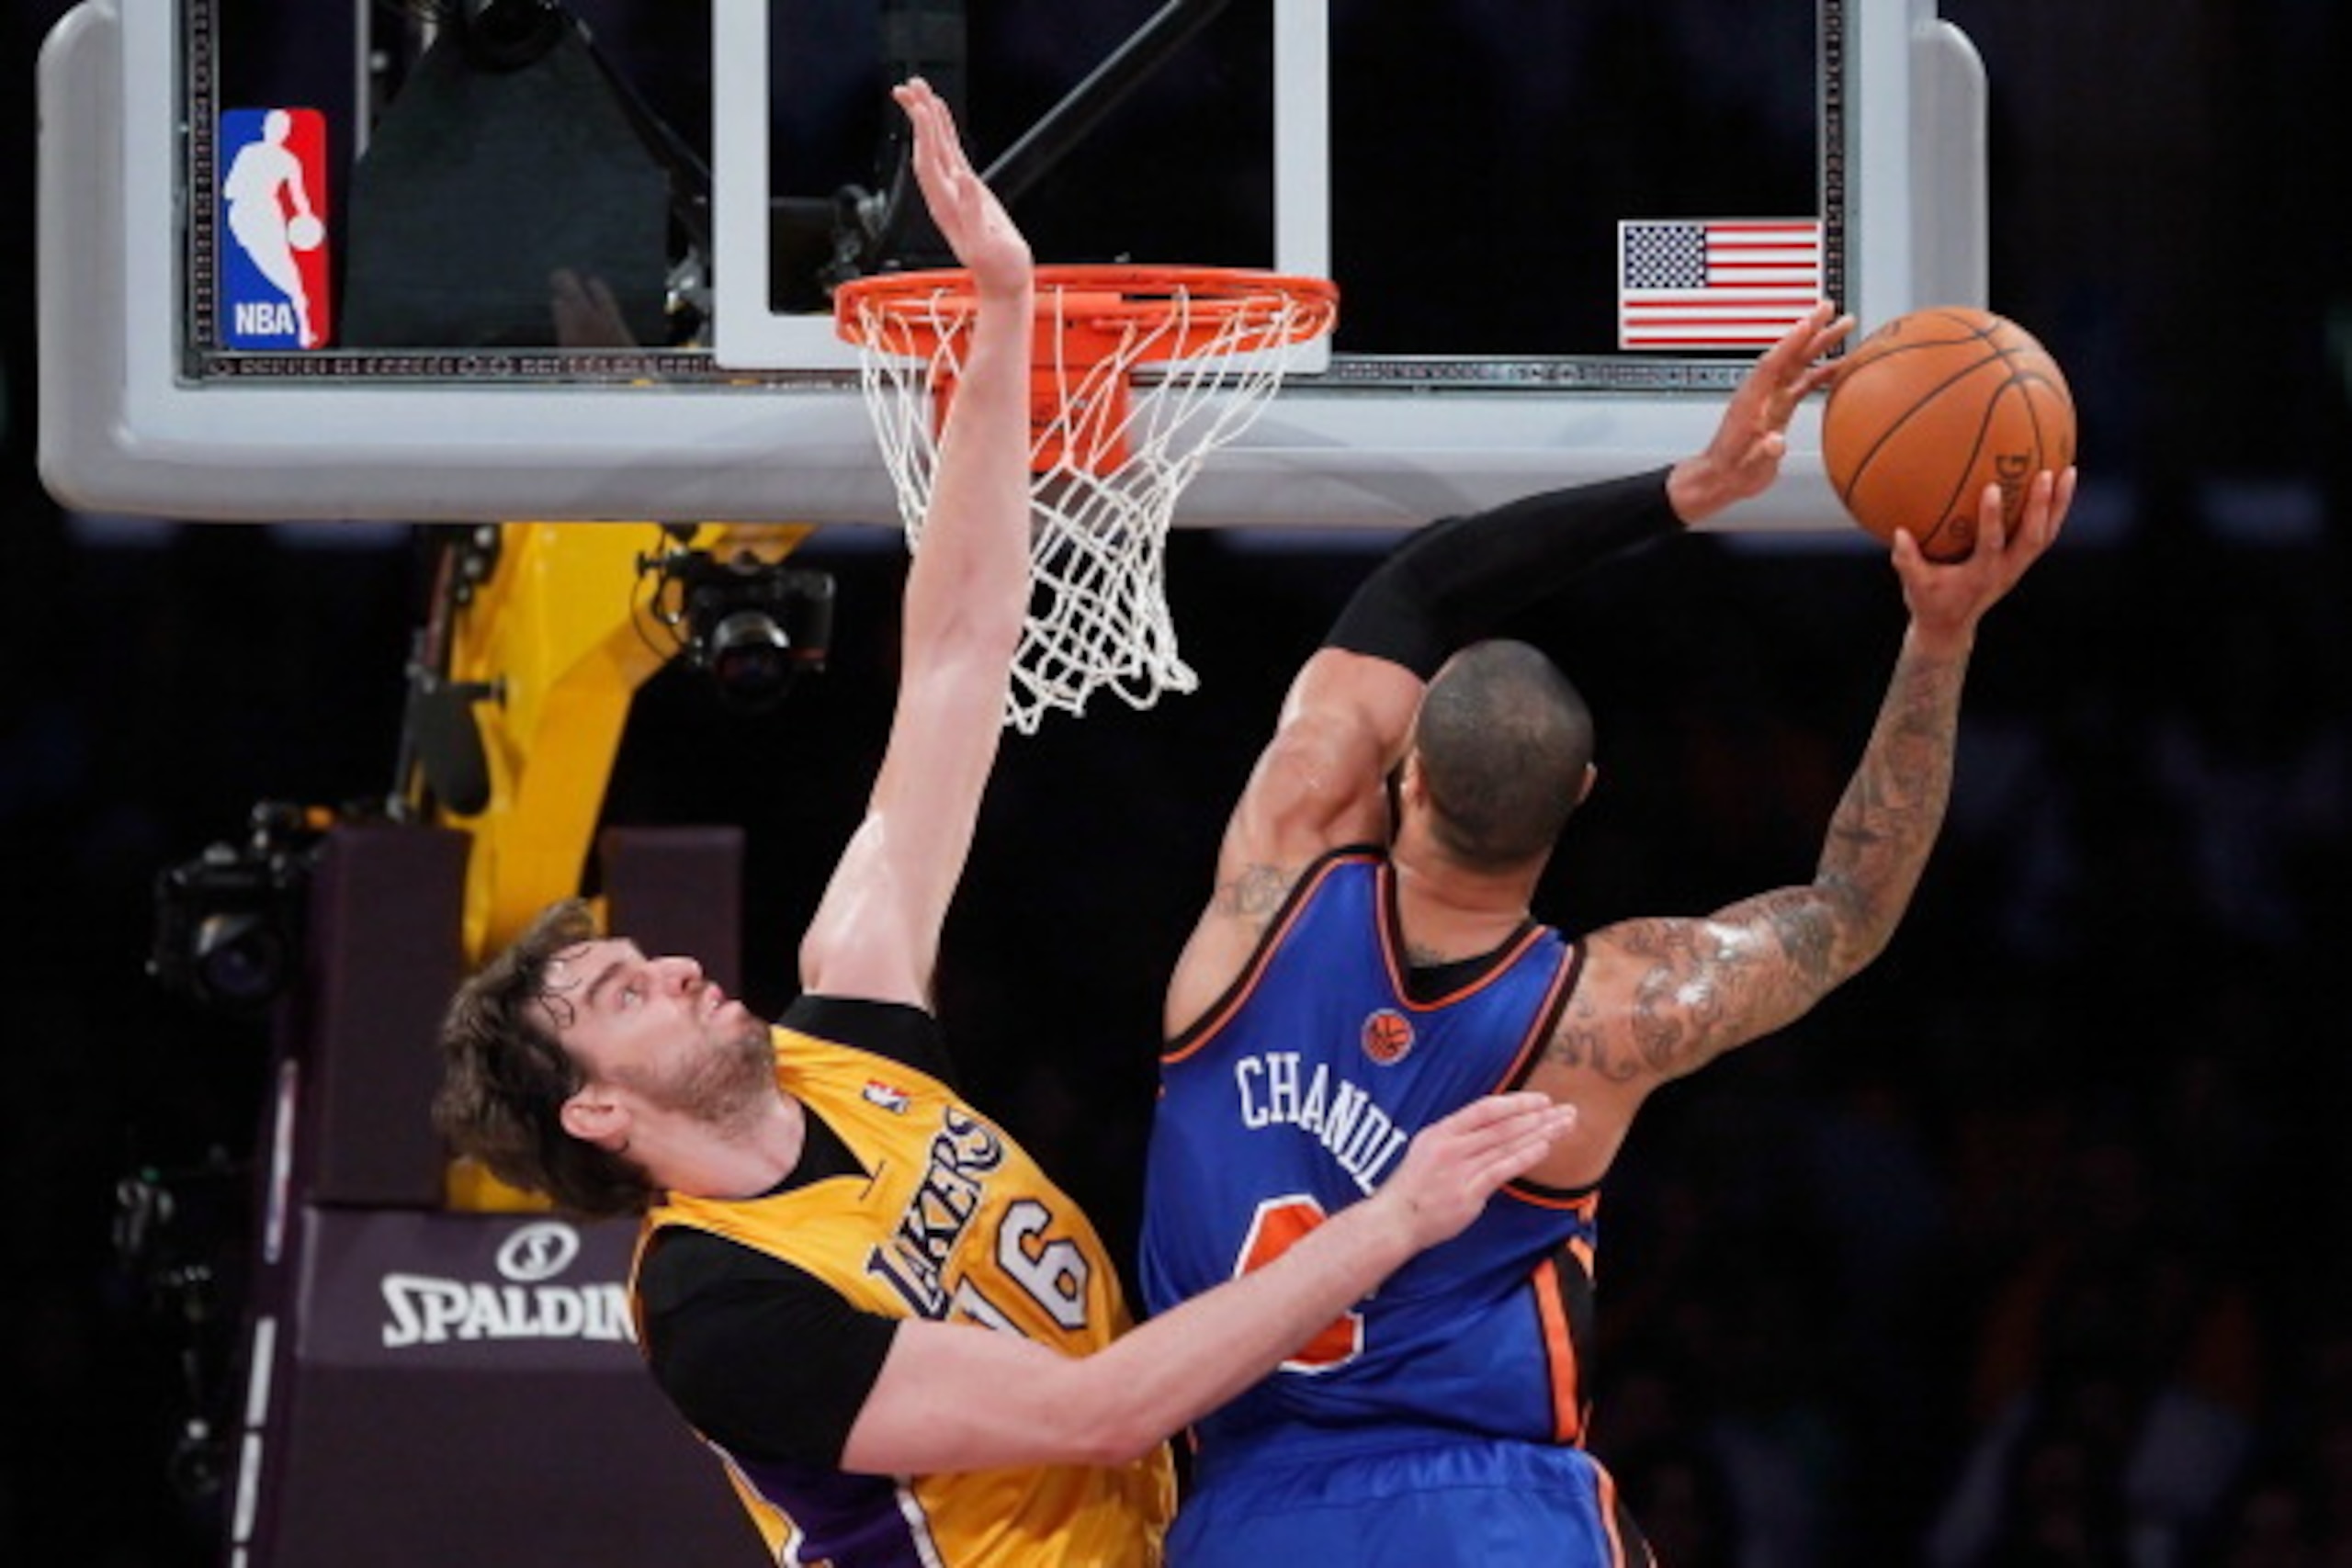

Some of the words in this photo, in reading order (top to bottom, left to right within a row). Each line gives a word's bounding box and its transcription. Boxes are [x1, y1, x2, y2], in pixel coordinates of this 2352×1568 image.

[235, 303, 295, 334] NBA
[867, 1106, 1003, 1321] LAKERS
[956, 1199, 1091, 1356] 16
